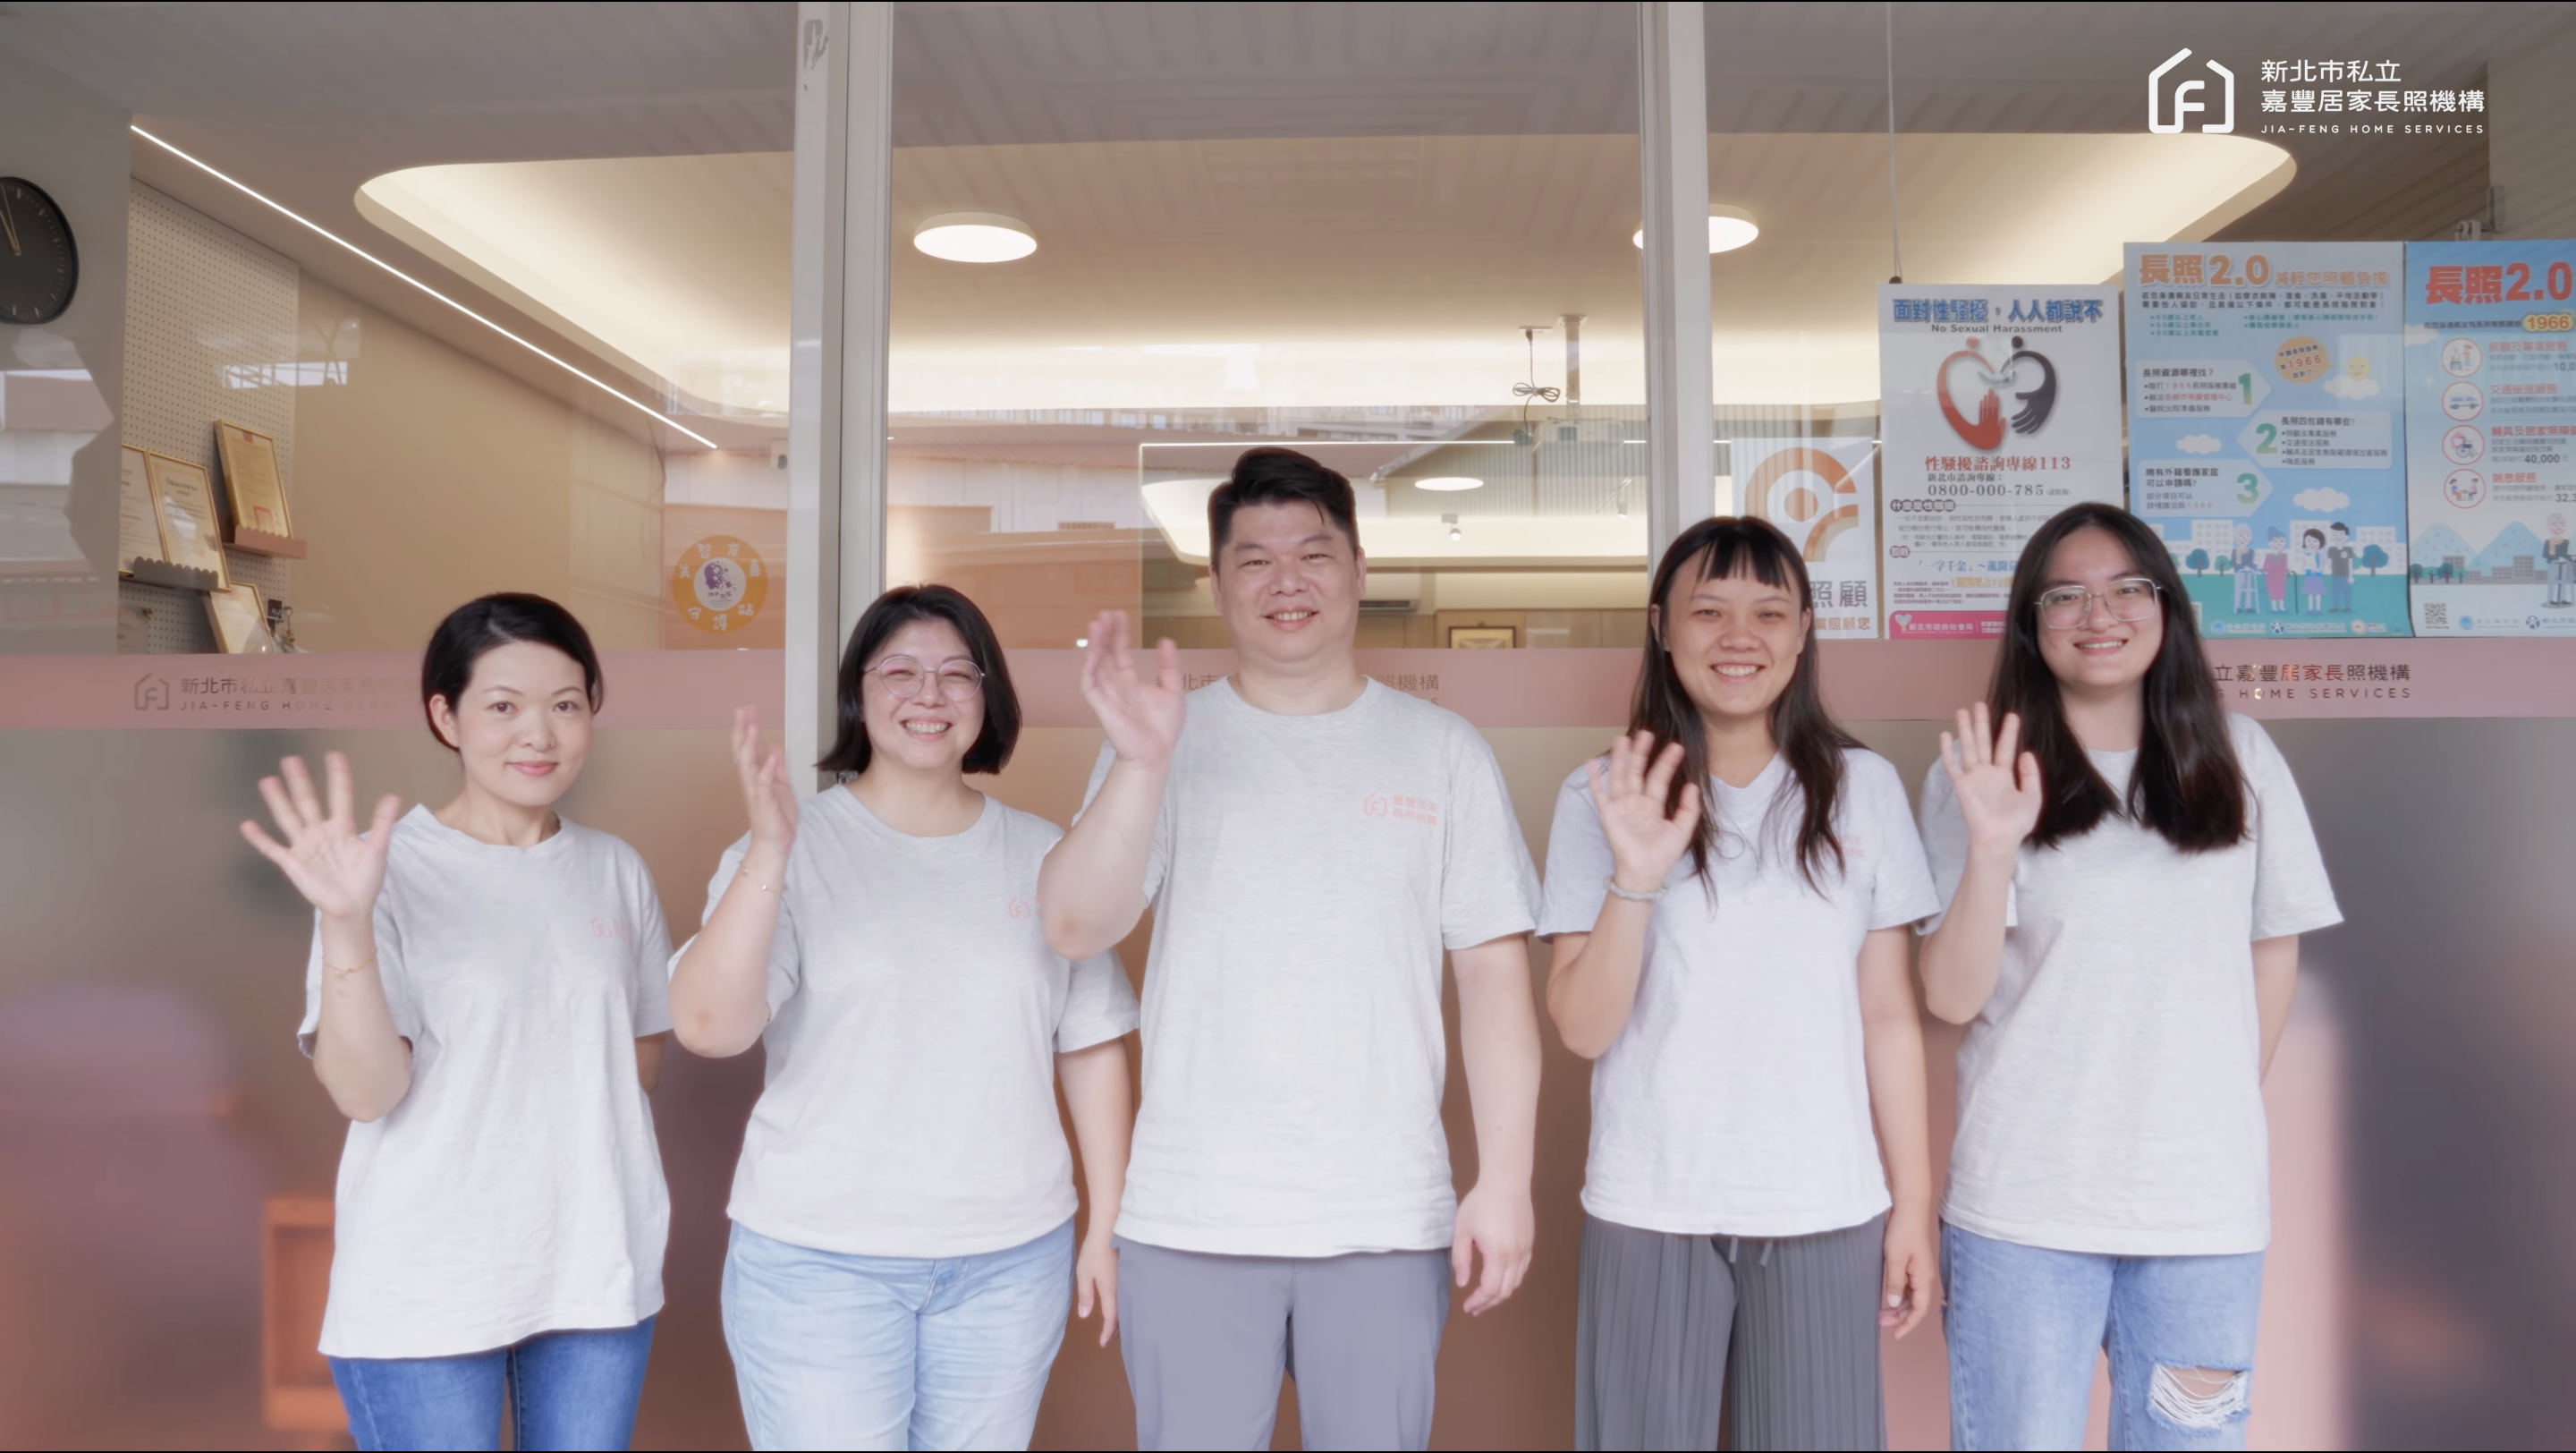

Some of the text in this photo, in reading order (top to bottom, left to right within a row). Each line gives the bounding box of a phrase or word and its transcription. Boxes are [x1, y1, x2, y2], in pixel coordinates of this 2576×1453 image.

[2138, 254, 2270, 286] 長照2.0
[2425, 261, 2573, 305] 長照2.0
[1931, 324, 2063, 333] No Sexual Harassment
[2527, 316, 2570, 329] 1966
[2238, 372, 2253, 404] 1
[2256, 423, 2278, 455] 2
[1925, 455, 2071, 472] 性騷擾諮詢專線113
[2524, 454, 2560, 463] 40,000
[1928, 484, 2044, 497] 0800-000-785
[2236, 472, 2259, 505] 3
[2240, 688, 2411, 699] HOME SERVICES
[180, 701, 269, 710] JIA-FENG
